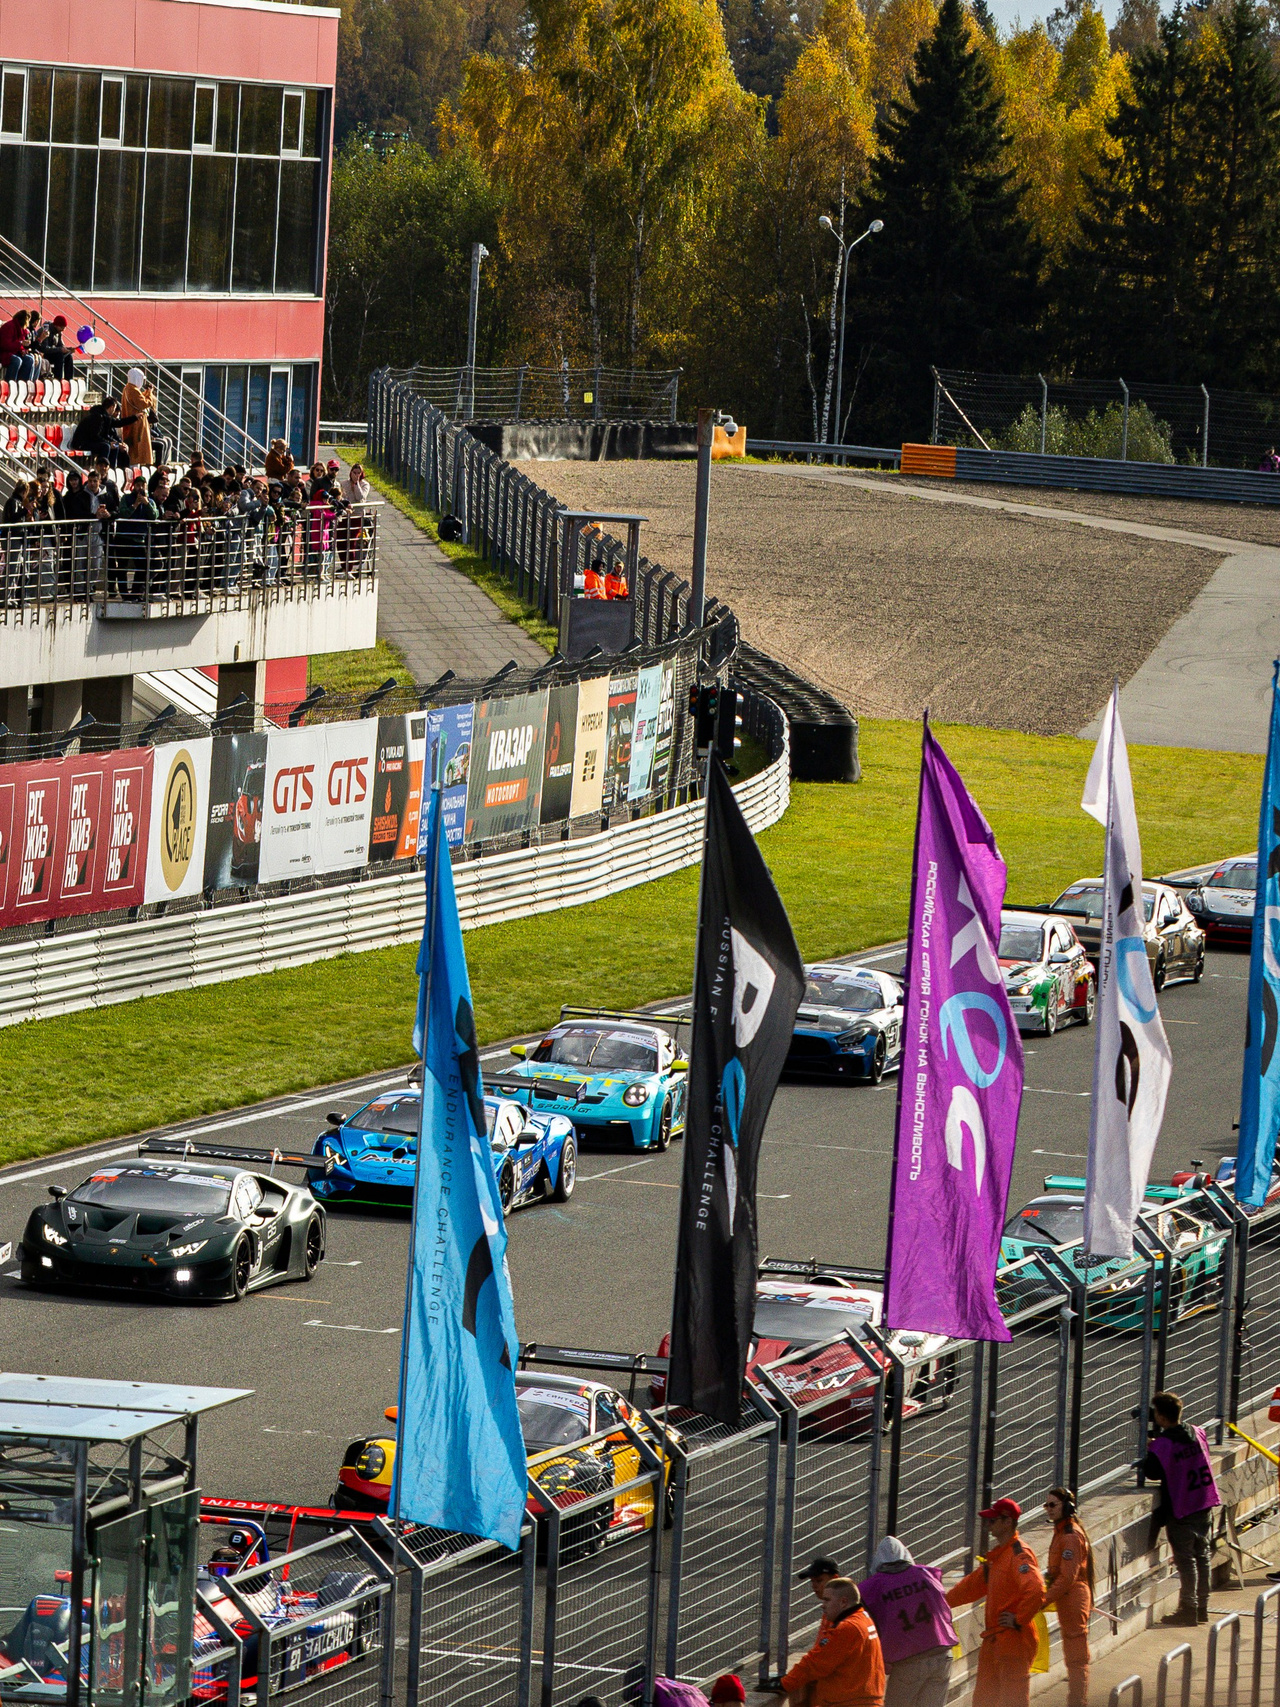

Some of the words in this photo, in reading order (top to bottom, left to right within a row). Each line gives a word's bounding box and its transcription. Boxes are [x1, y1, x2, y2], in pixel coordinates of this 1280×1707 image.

[581, 711, 603, 733] HYPERCAR
[488, 725, 533, 771] КВАЗАР
[114, 778, 131, 811] РГС
[273, 764, 314, 814] GTS
[327, 757, 368, 806] GTS
[486, 783, 520, 803] МОТОСПОРТ
[27, 789, 45, 829] РГС
[72, 782, 89, 819] РГС
[26, 826, 49, 860] ЖИЗ
[71, 818, 92, 853] ЖИЗ
[113, 812, 133, 846] ЖИЗ
[21, 861, 36, 896] НЬ
[64, 853, 79, 888] НЬ
[106, 847, 122, 881] НЬ
[922, 861, 937, 948] РОССИЙСКАЯ
[921, 953, 930, 995] СЕРИЯ
[919, 1000, 930, 1043] ГОНОК
[918, 1049, 927, 1067] НА
[441, 1073, 458, 1195] ENDURANCE
[910, 1073, 927, 1181] ВЫНОСЛИВОСТЬ
[696, 1124, 723, 1231] CHALLENGE
[428, 1198, 448, 1325] CHALLENGE
[546, 1393, 586, 1407] СИНТЕРА
[1187, 1465, 1212, 1492] 25
[881, 1579, 931, 1602] MEDIA
[898, 1601, 933, 1632] 14
[290, 1648, 301, 1671] 21
